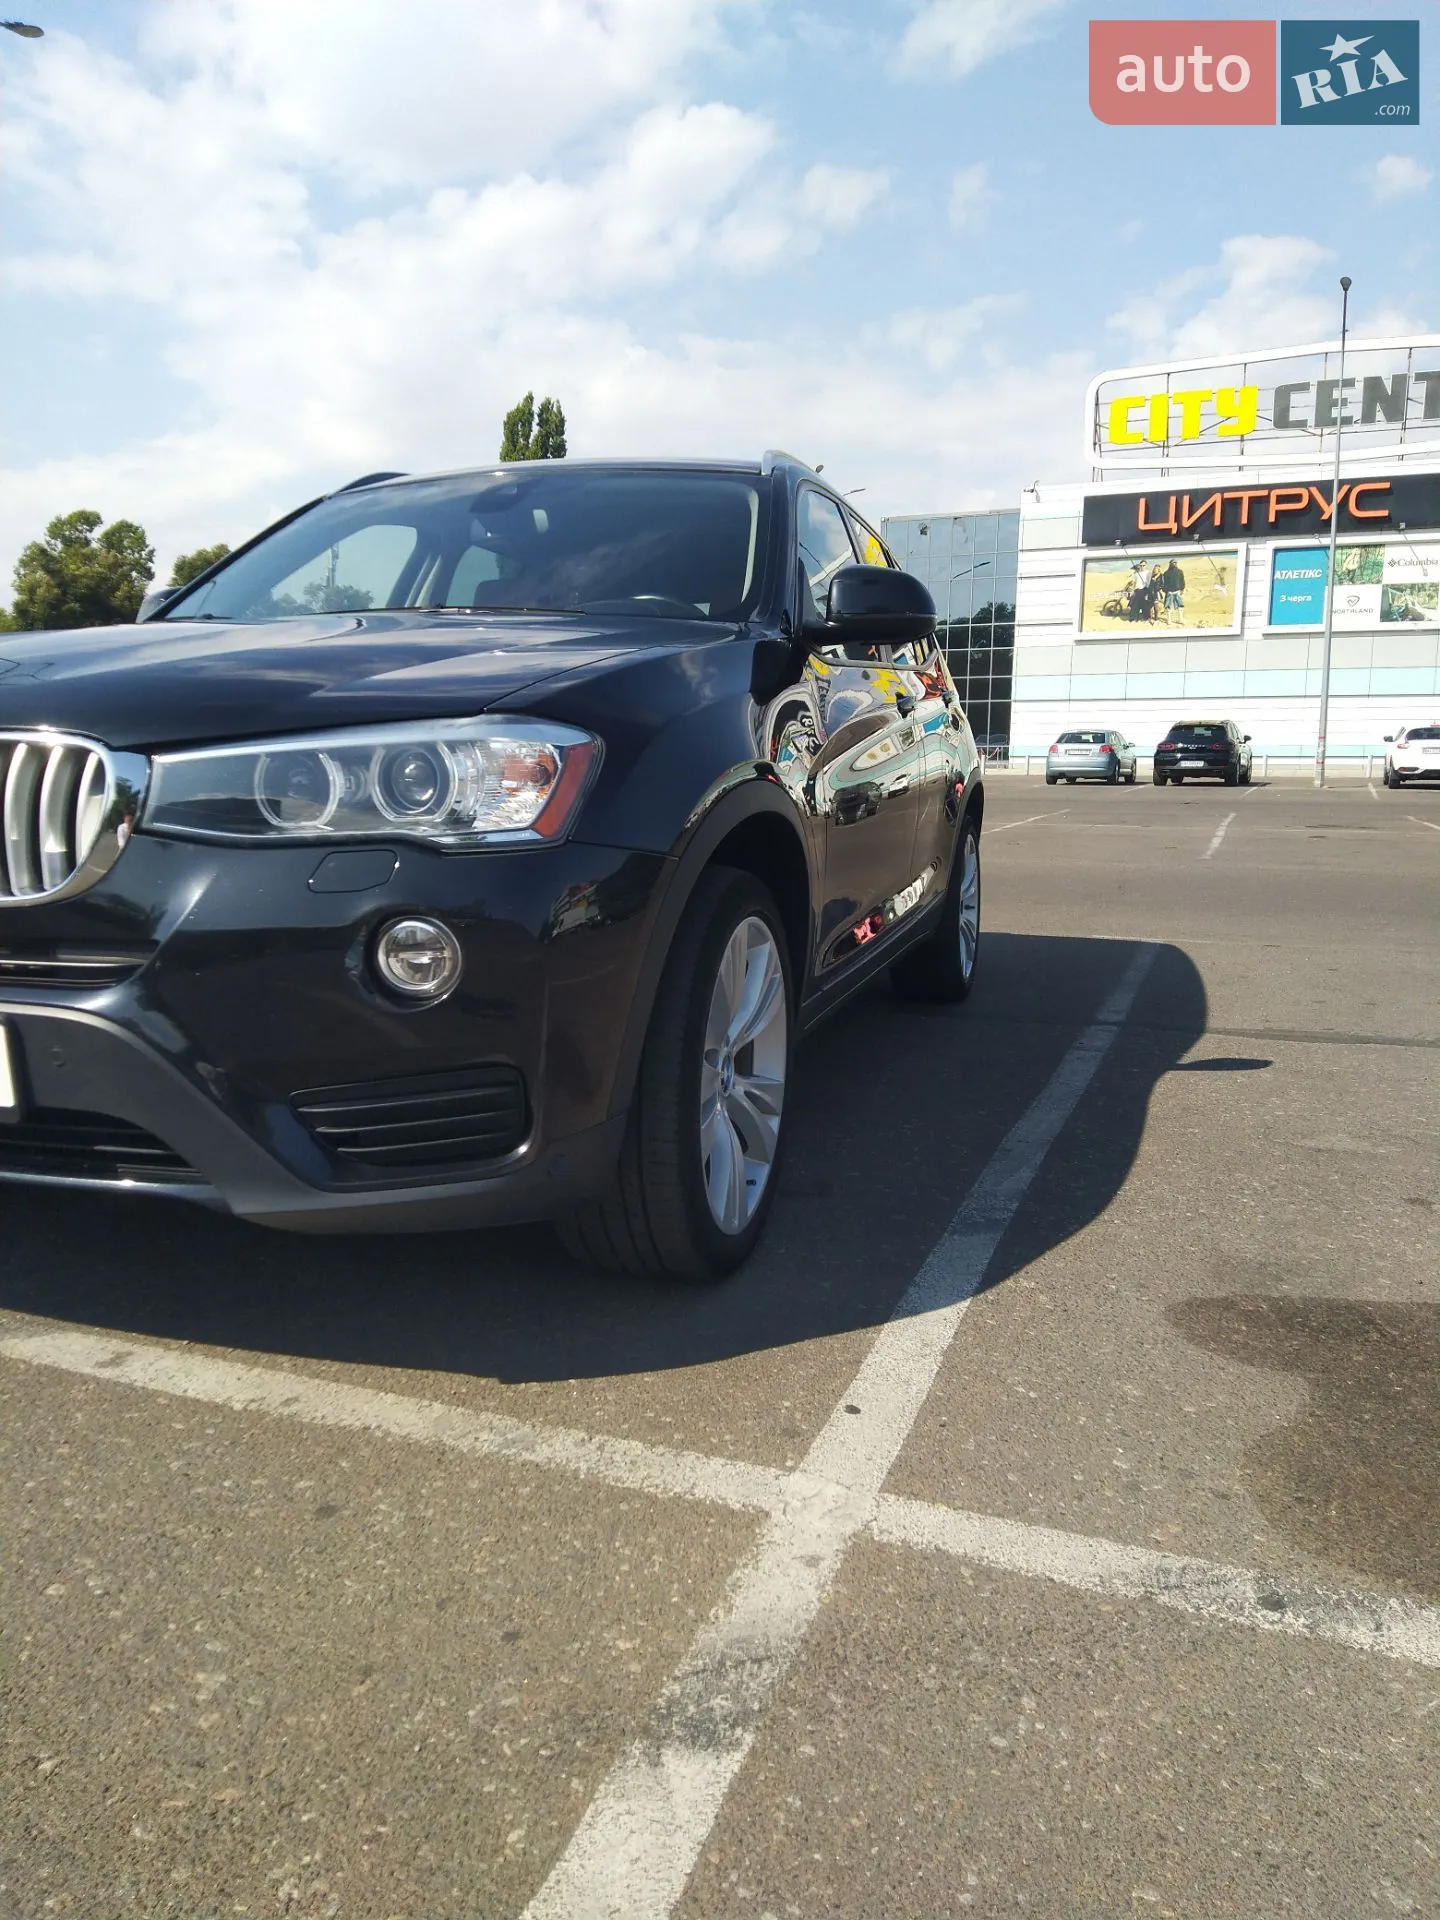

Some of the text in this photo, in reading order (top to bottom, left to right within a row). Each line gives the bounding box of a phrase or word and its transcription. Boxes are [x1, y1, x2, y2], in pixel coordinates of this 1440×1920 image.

[1108, 385, 1258, 446] CITY
[1137, 482, 1391, 536] ЦИТРУС
[1397, 557, 1439, 567] Columbia
